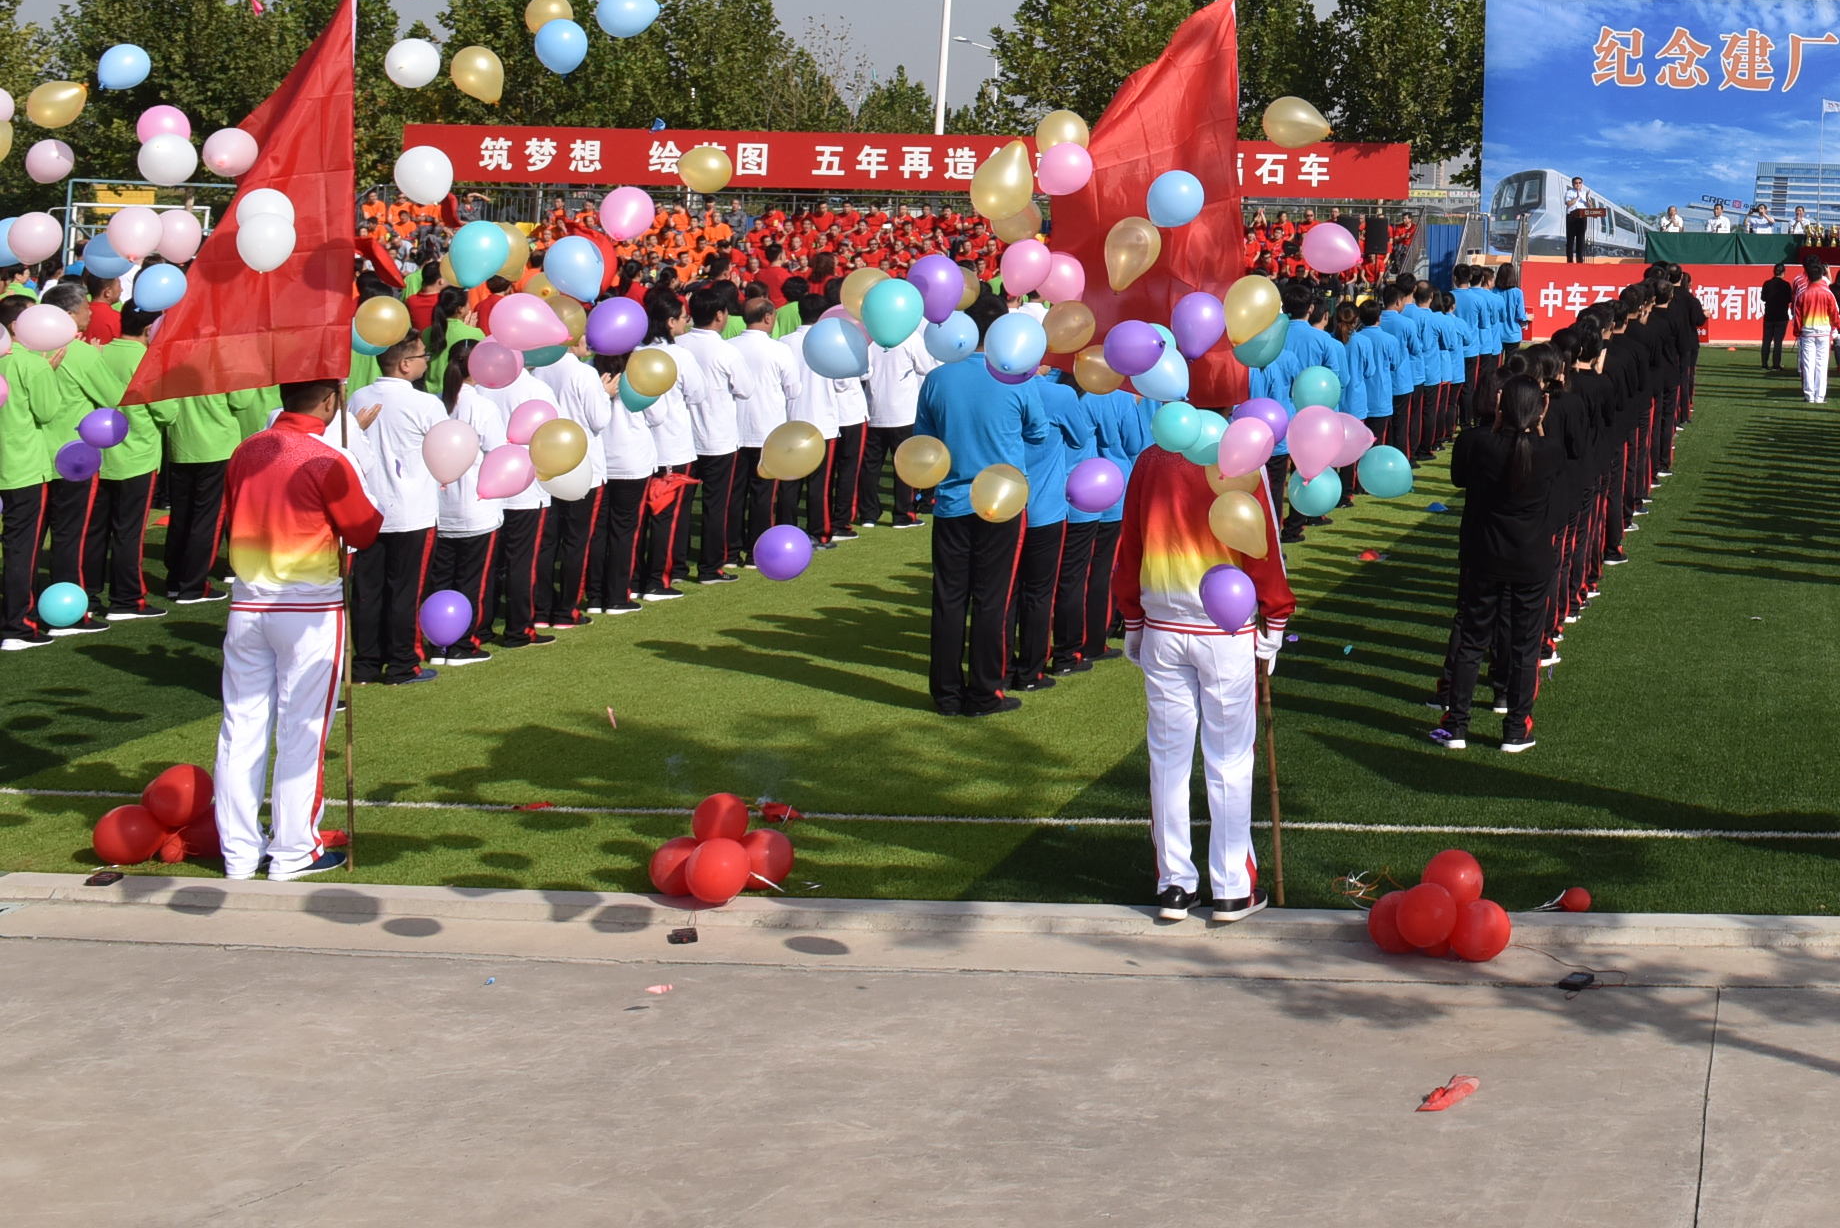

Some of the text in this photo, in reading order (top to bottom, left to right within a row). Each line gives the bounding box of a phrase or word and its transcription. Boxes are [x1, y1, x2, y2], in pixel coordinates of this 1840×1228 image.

[478, 137, 602, 173] 筑梦想
[648, 141, 769, 176] 绘图
[1237, 152, 1330, 187] 石车
[1701, 194, 1731, 206] CRRC
